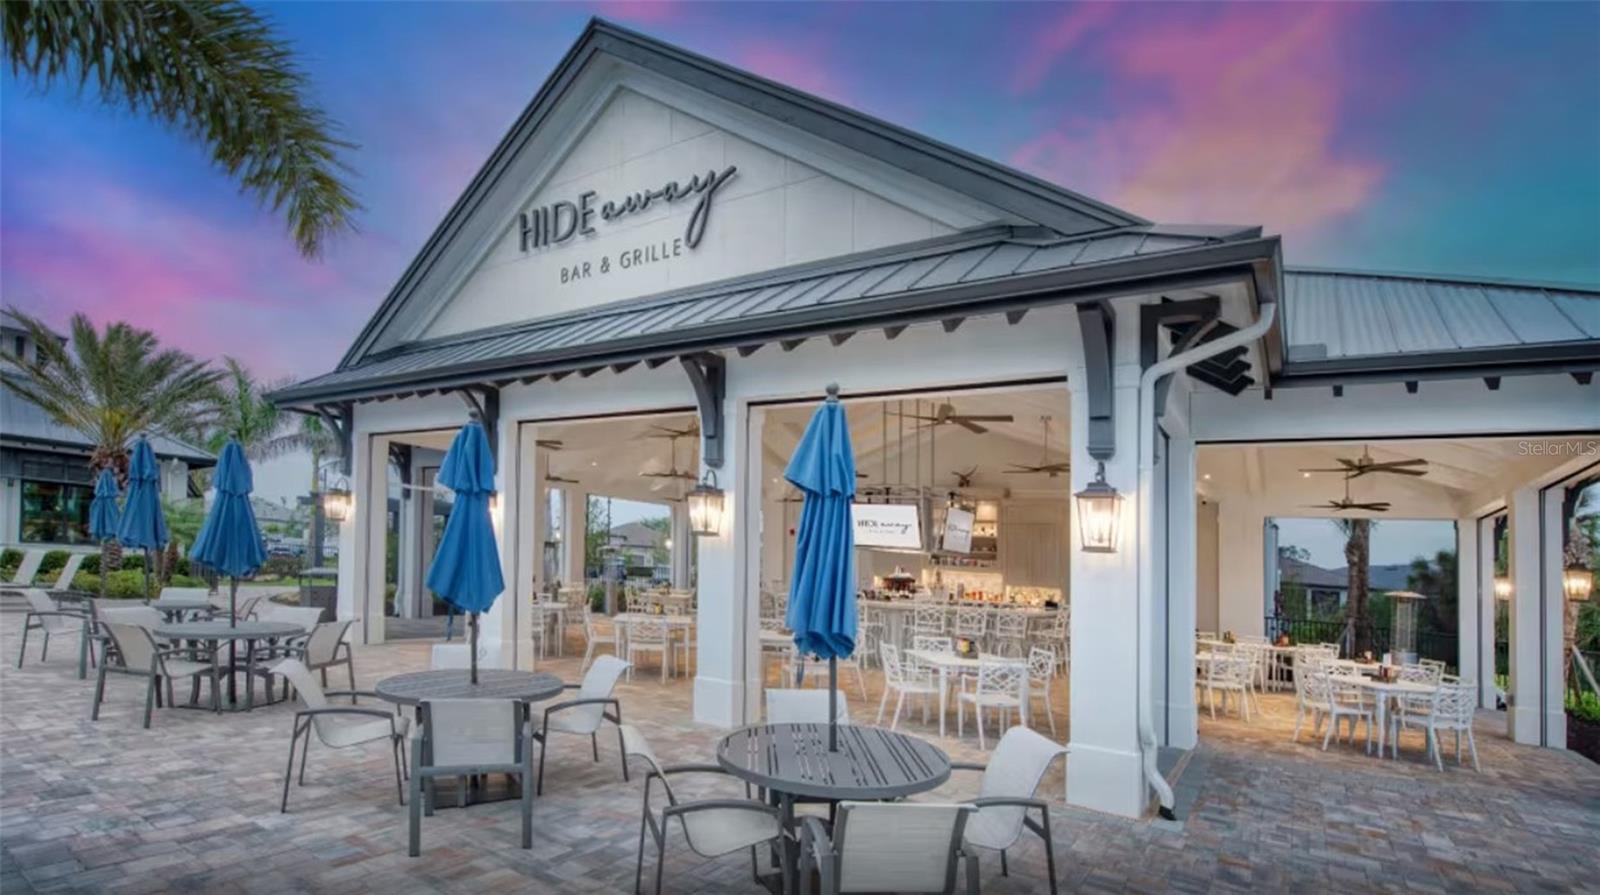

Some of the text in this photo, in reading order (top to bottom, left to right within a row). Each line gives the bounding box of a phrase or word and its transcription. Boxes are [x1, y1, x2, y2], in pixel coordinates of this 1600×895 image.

[560, 238, 682, 283] BAR & GRILLE
